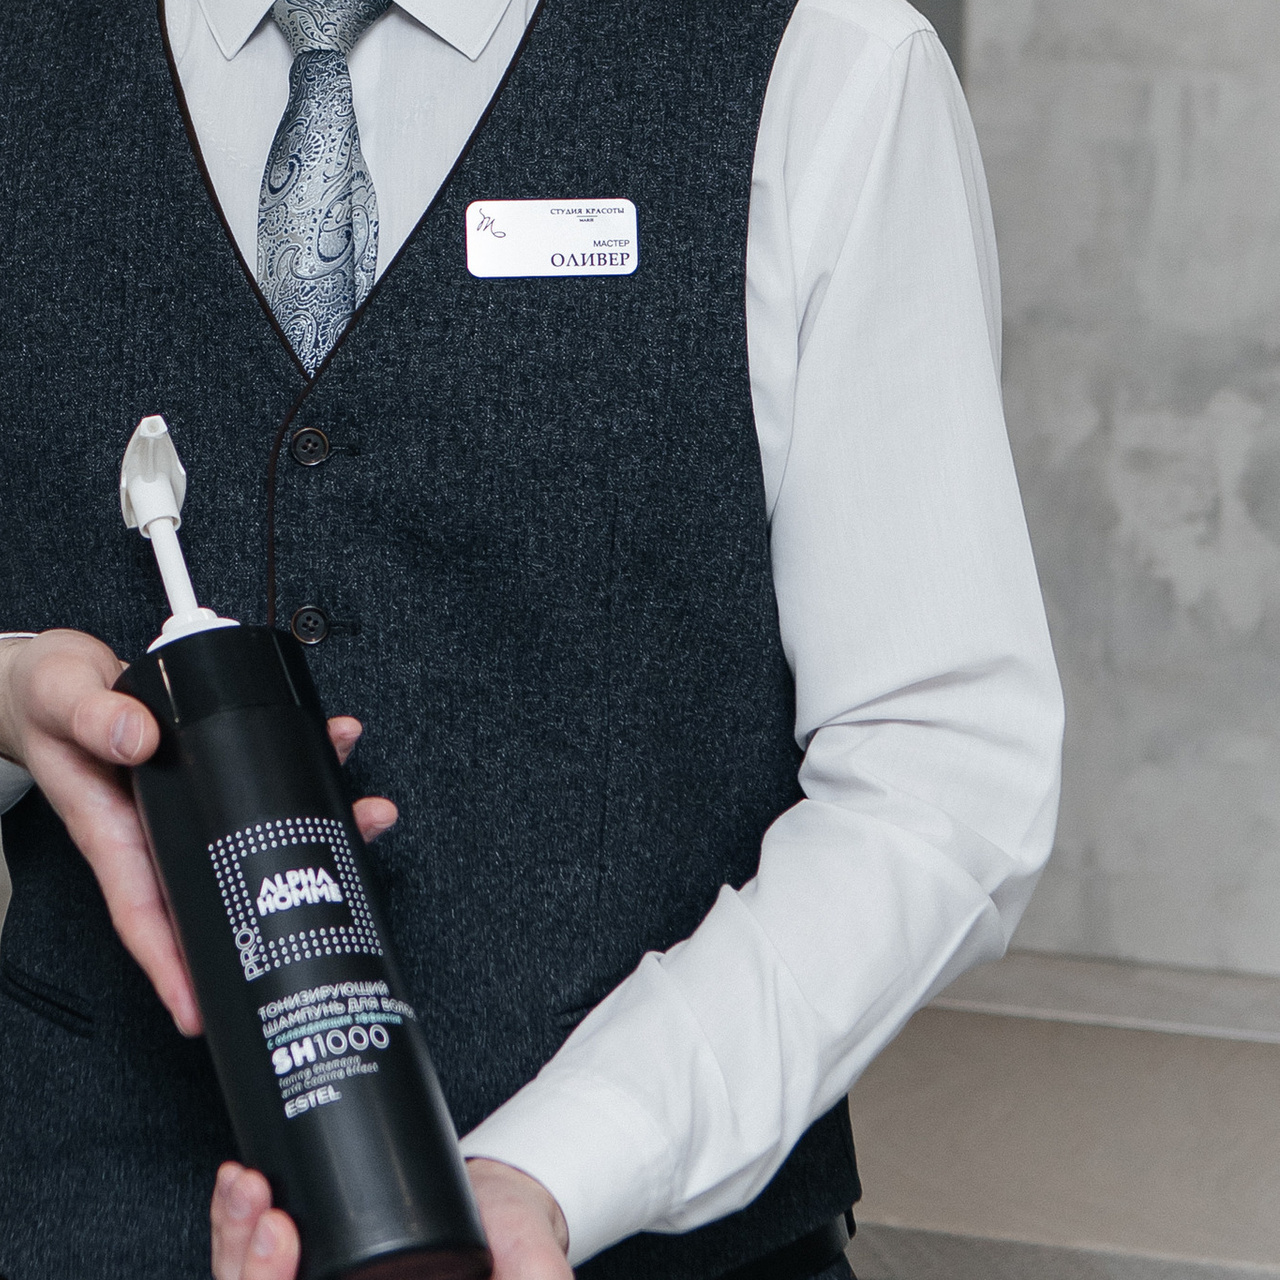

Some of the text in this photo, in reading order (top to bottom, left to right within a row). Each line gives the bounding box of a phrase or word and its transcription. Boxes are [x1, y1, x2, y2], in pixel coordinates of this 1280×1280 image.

[585, 207, 625, 215] КРАСОТЫ
[550, 252, 630, 267] ОЛИВЕР
[593, 239, 630, 248] МАСТЕР
[256, 882, 344, 916] HOMME
[260, 867, 334, 898] ALPHA
[235, 928, 265, 981] PRO
[258, 980, 390, 1022] ТОНИЗИРУЮЩИЙ
[262, 1000, 346, 1038] ШАМПУНЬ
[348, 997, 380, 1014] ДЛЯ
[271, 1024, 389, 1074] SH1000
[284, 1084, 342, 1118] ESTEL
